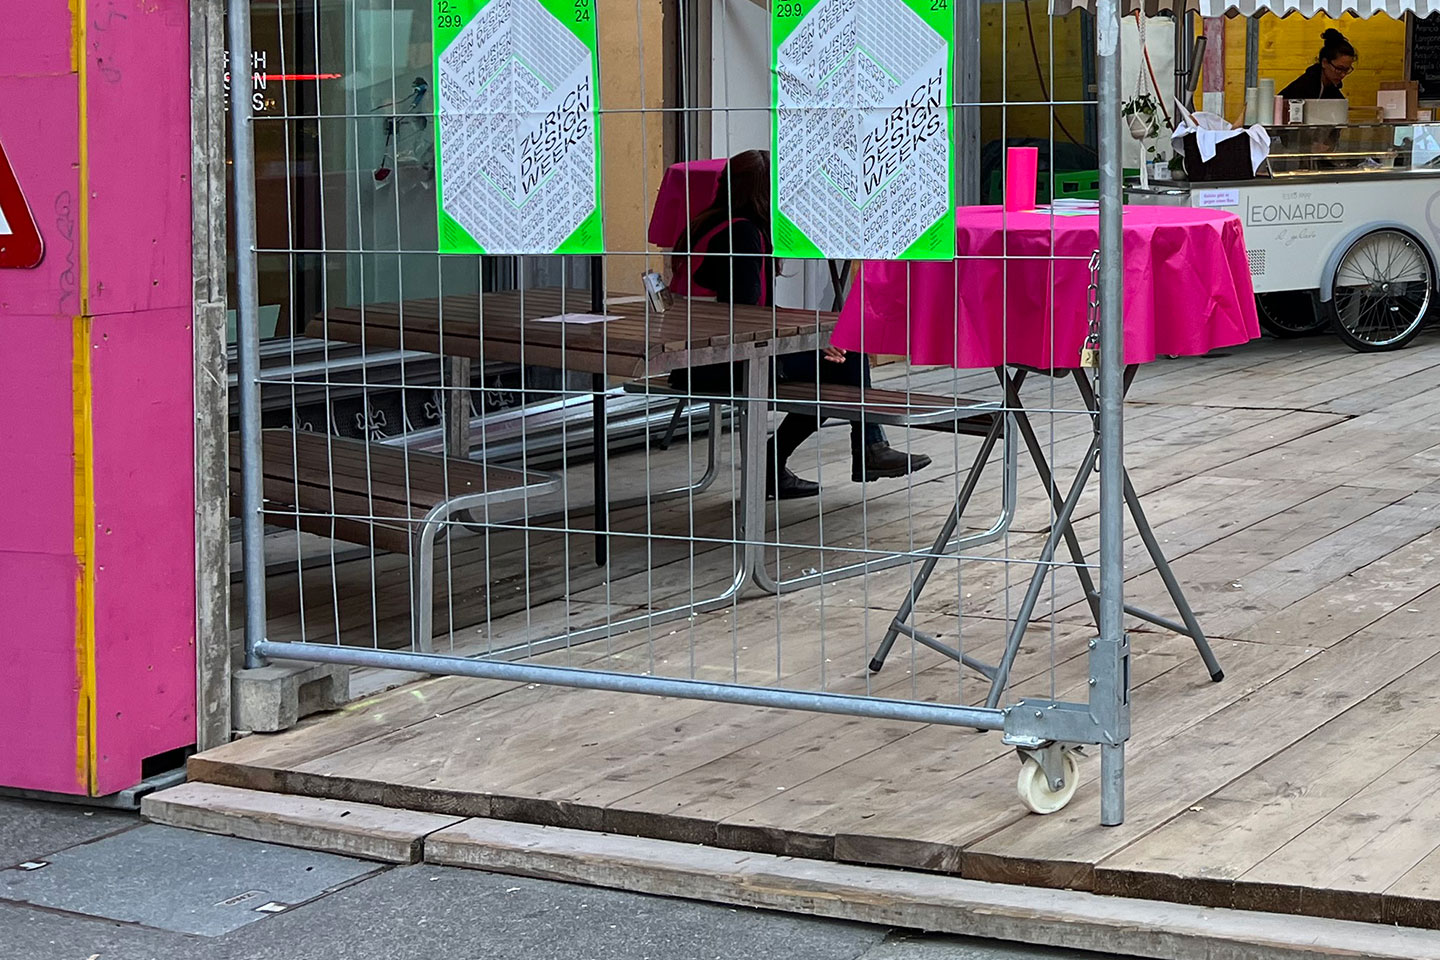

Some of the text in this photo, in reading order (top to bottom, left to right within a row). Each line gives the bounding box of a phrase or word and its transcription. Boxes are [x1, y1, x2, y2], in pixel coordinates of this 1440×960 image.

[437, 15, 463, 28] 29.9.
[575, 9, 591, 22] 24
[776, 3, 804, 18] 29.9.
[520, 75, 589, 158] ZURICH
[521, 95, 590, 177] DESIGN
[862, 68, 943, 156] ZURICH
[862, 88, 942, 176] DESIGN
[1247, 195, 1345, 227] LEONARDO
